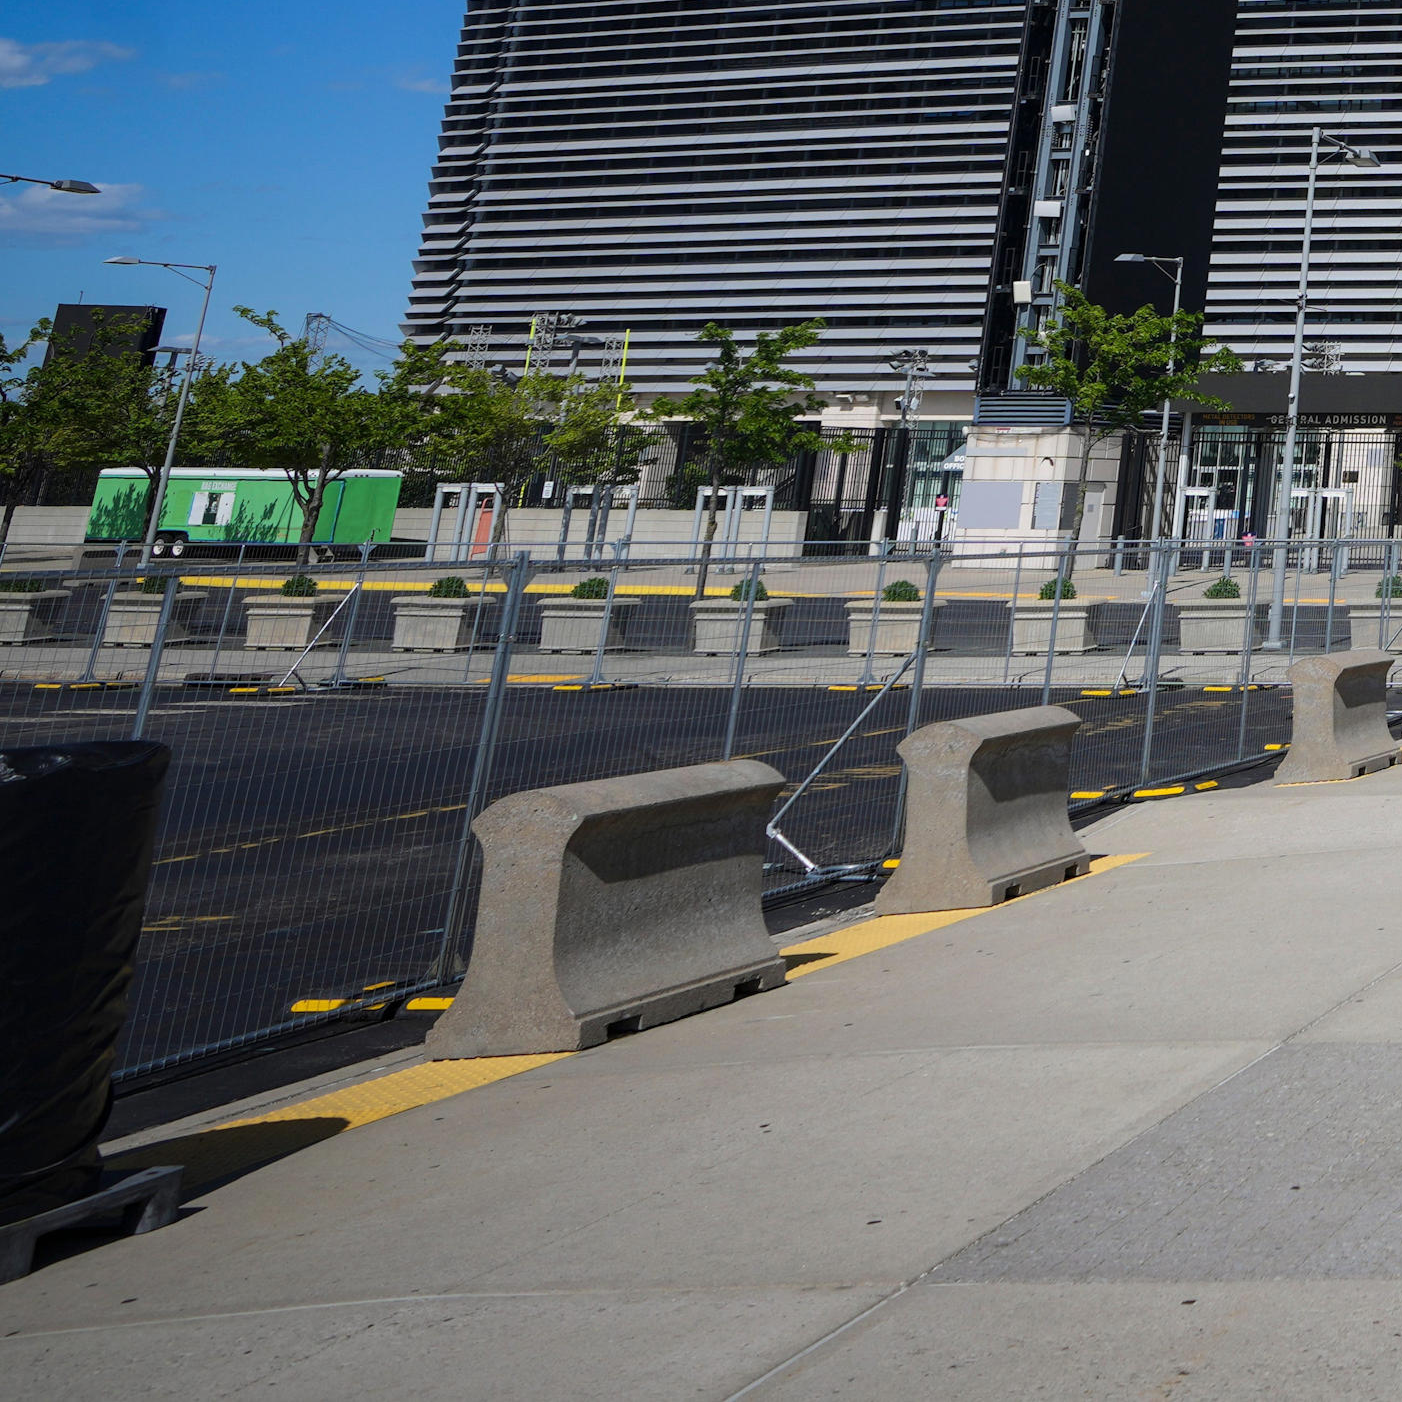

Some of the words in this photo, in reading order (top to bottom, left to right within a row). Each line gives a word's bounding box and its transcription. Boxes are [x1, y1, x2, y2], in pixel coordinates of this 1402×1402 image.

[1271, 415, 1321, 424] GERAL
[1325, 415, 1387, 424] ADMISSION
[943, 462, 965, 470] OFFIC
